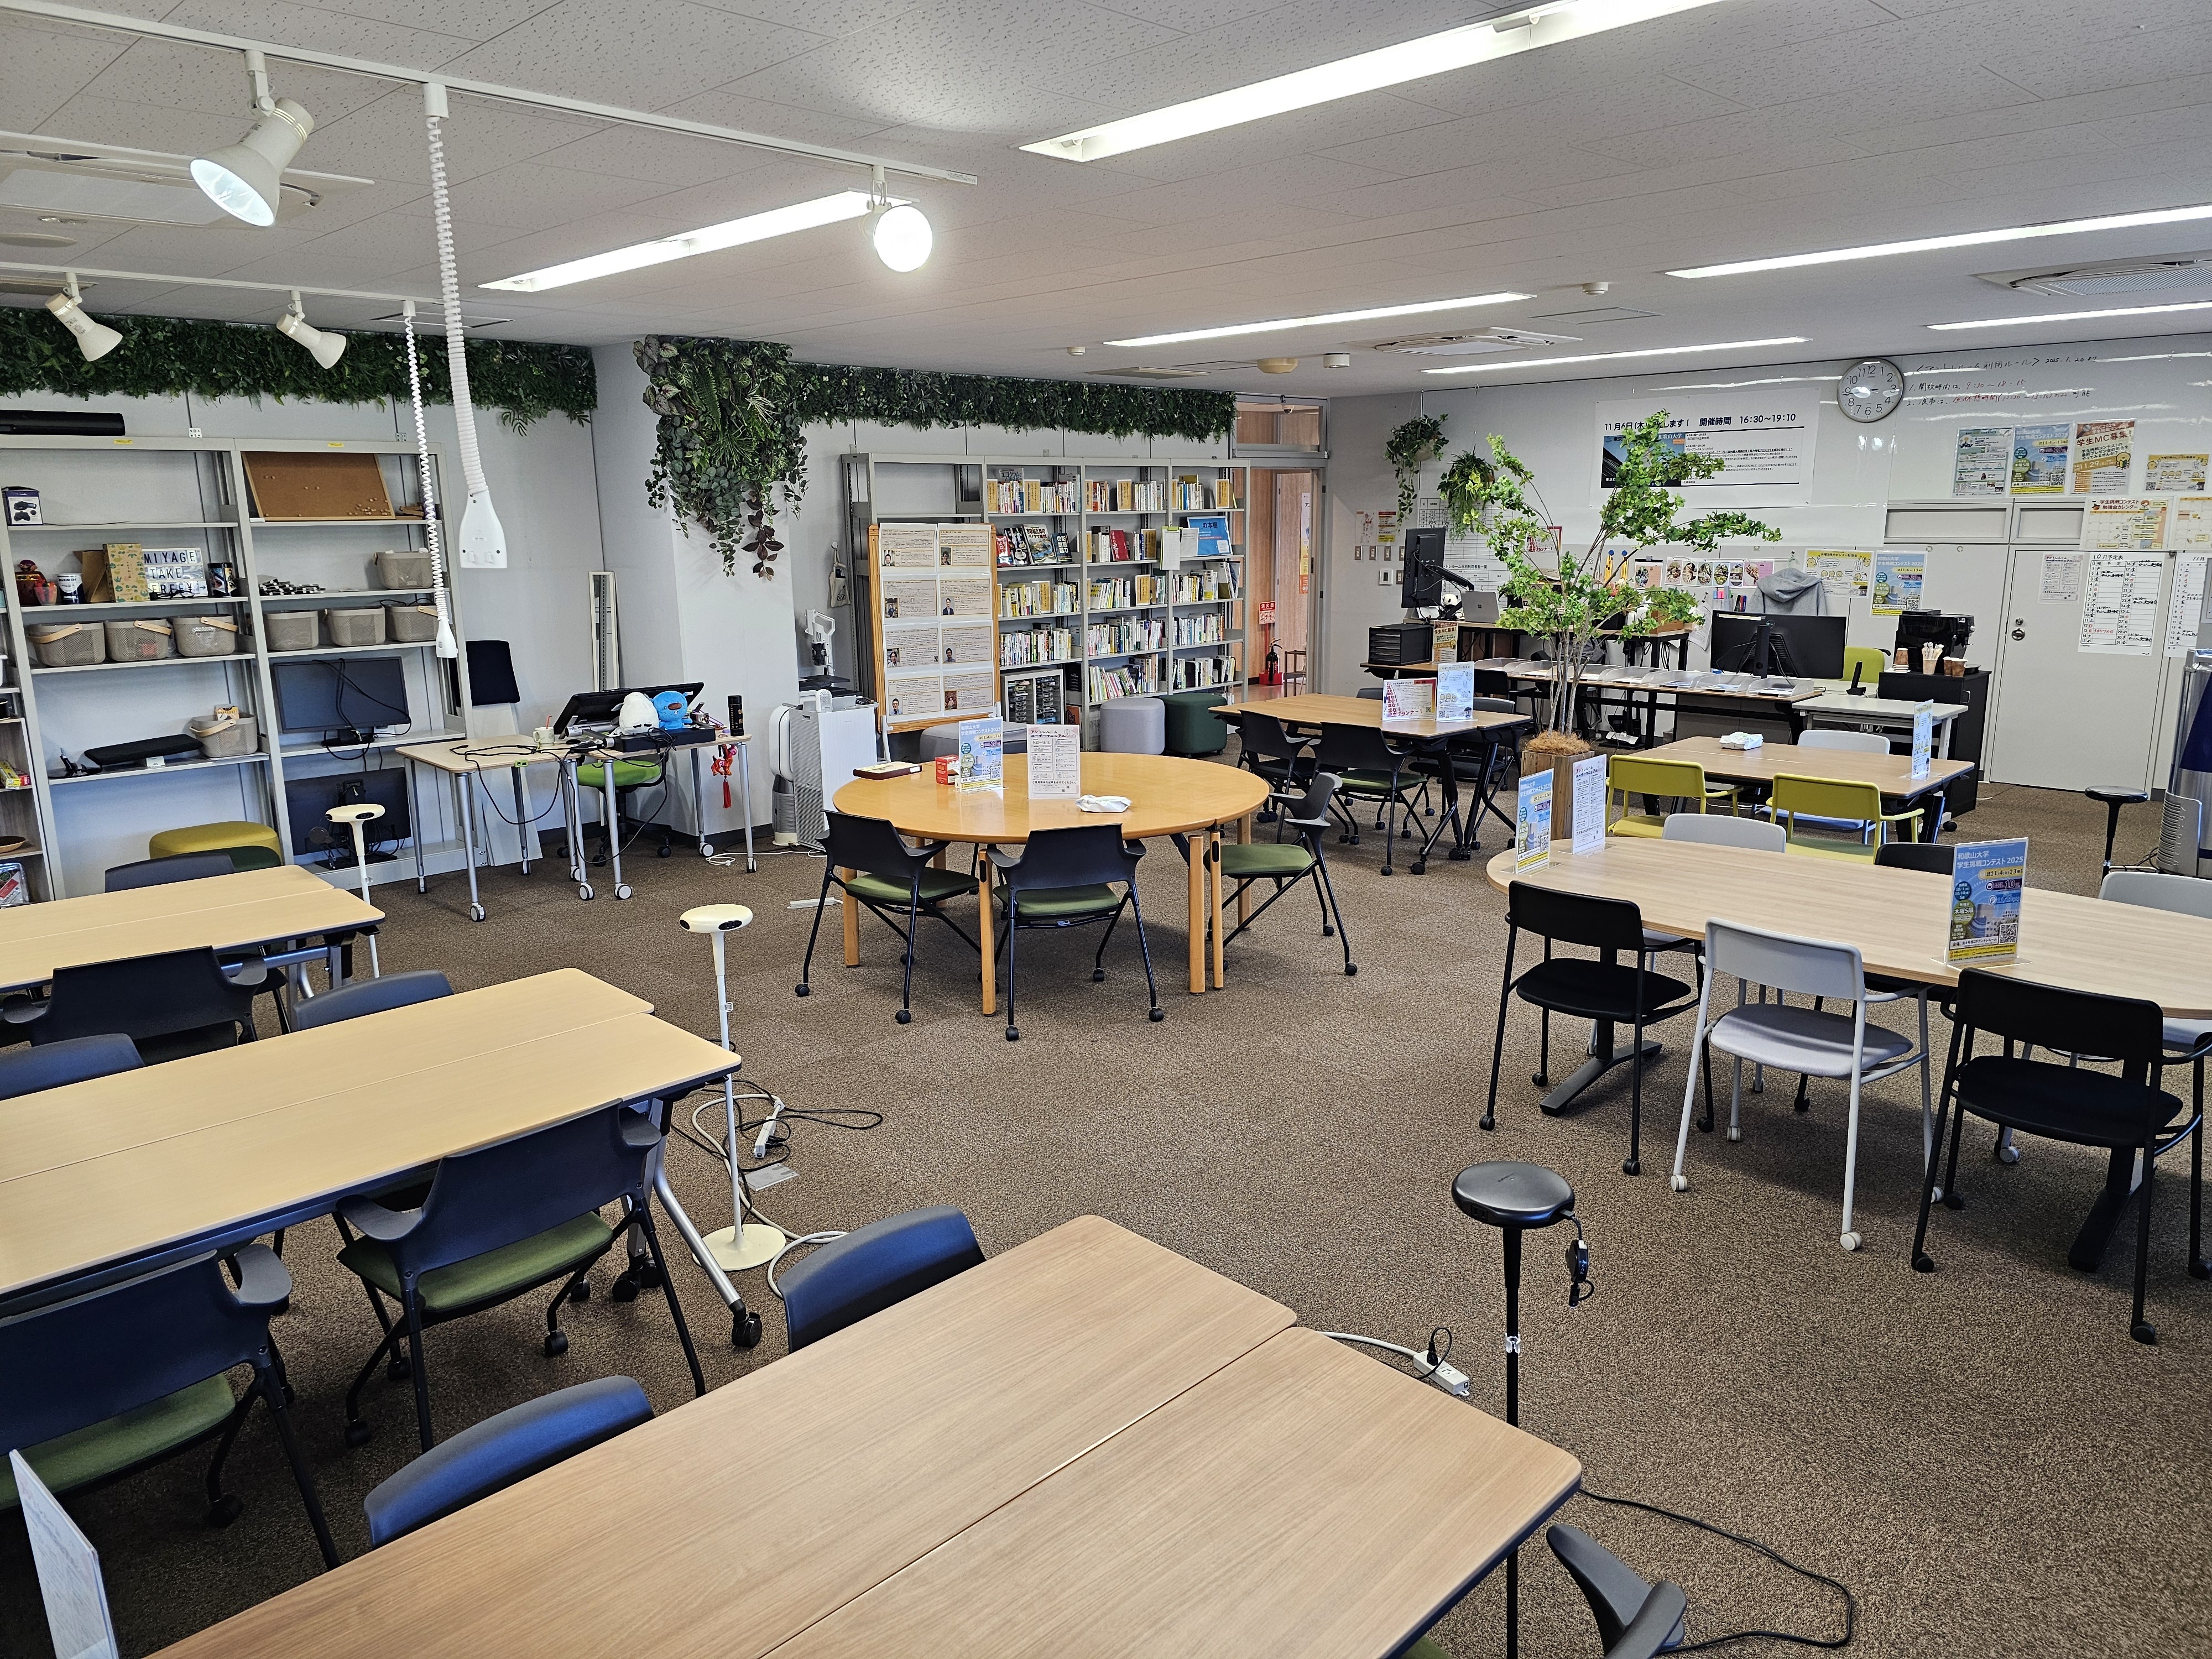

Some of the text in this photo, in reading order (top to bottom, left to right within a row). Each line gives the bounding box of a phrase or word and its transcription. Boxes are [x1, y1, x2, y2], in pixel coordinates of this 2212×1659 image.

[1859, 368, 1865, 377] 11
[1868, 366, 1876, 374] 12
[1887, 373, 1893, 382] 2
[1890, 384, 1896, 393] 3
[1848, 398, 1854, 406] 8
[1865, 407, 1871, 415] 6
[1876, 404, 1882, 413] 5
[1699, 416, 1732, 426] 開催時間
[144, 551, 196, 564] MIYAGE
[150, 568, 182, 578] TAKE
[1958, 851, 1989, 860] 和歌山大学
[1957, 858, 2006, 869] 学生挑戦コンテスト
